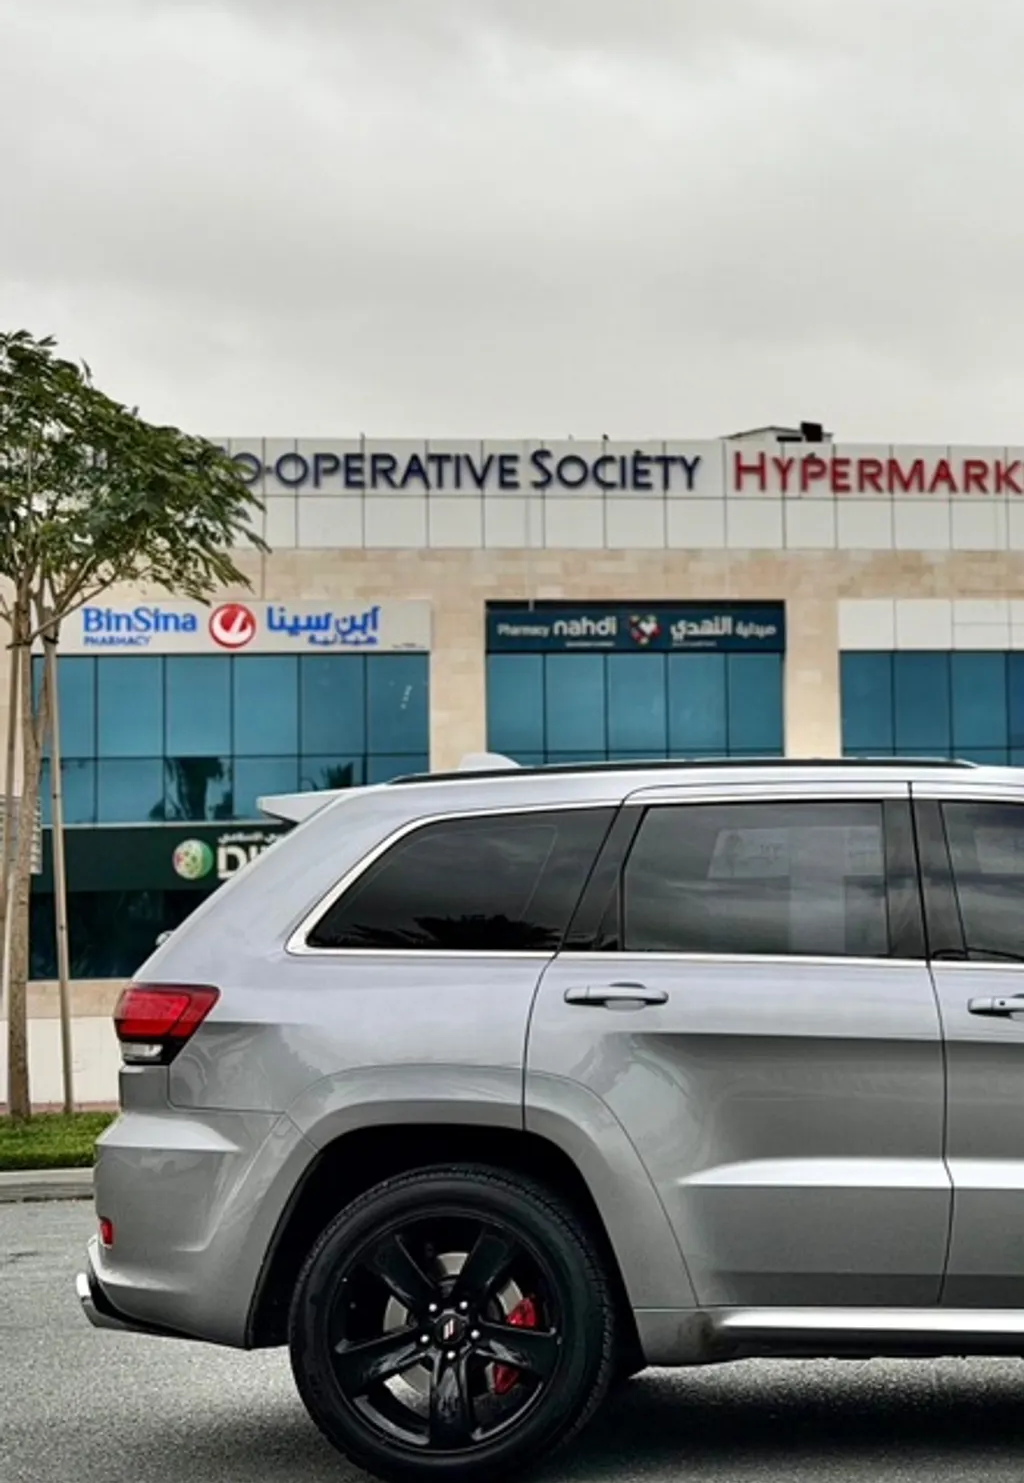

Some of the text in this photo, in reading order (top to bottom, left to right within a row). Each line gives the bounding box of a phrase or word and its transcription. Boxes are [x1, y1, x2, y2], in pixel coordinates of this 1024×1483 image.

[226, 452, 520, 490] O-OPERATIVE
[530, 449, 701, 491] SOCIETY
[82, 606, 197, 632] BinSina
[266, 606, 332, 636] سينا
[553, 615, 617, 636] nahdi
